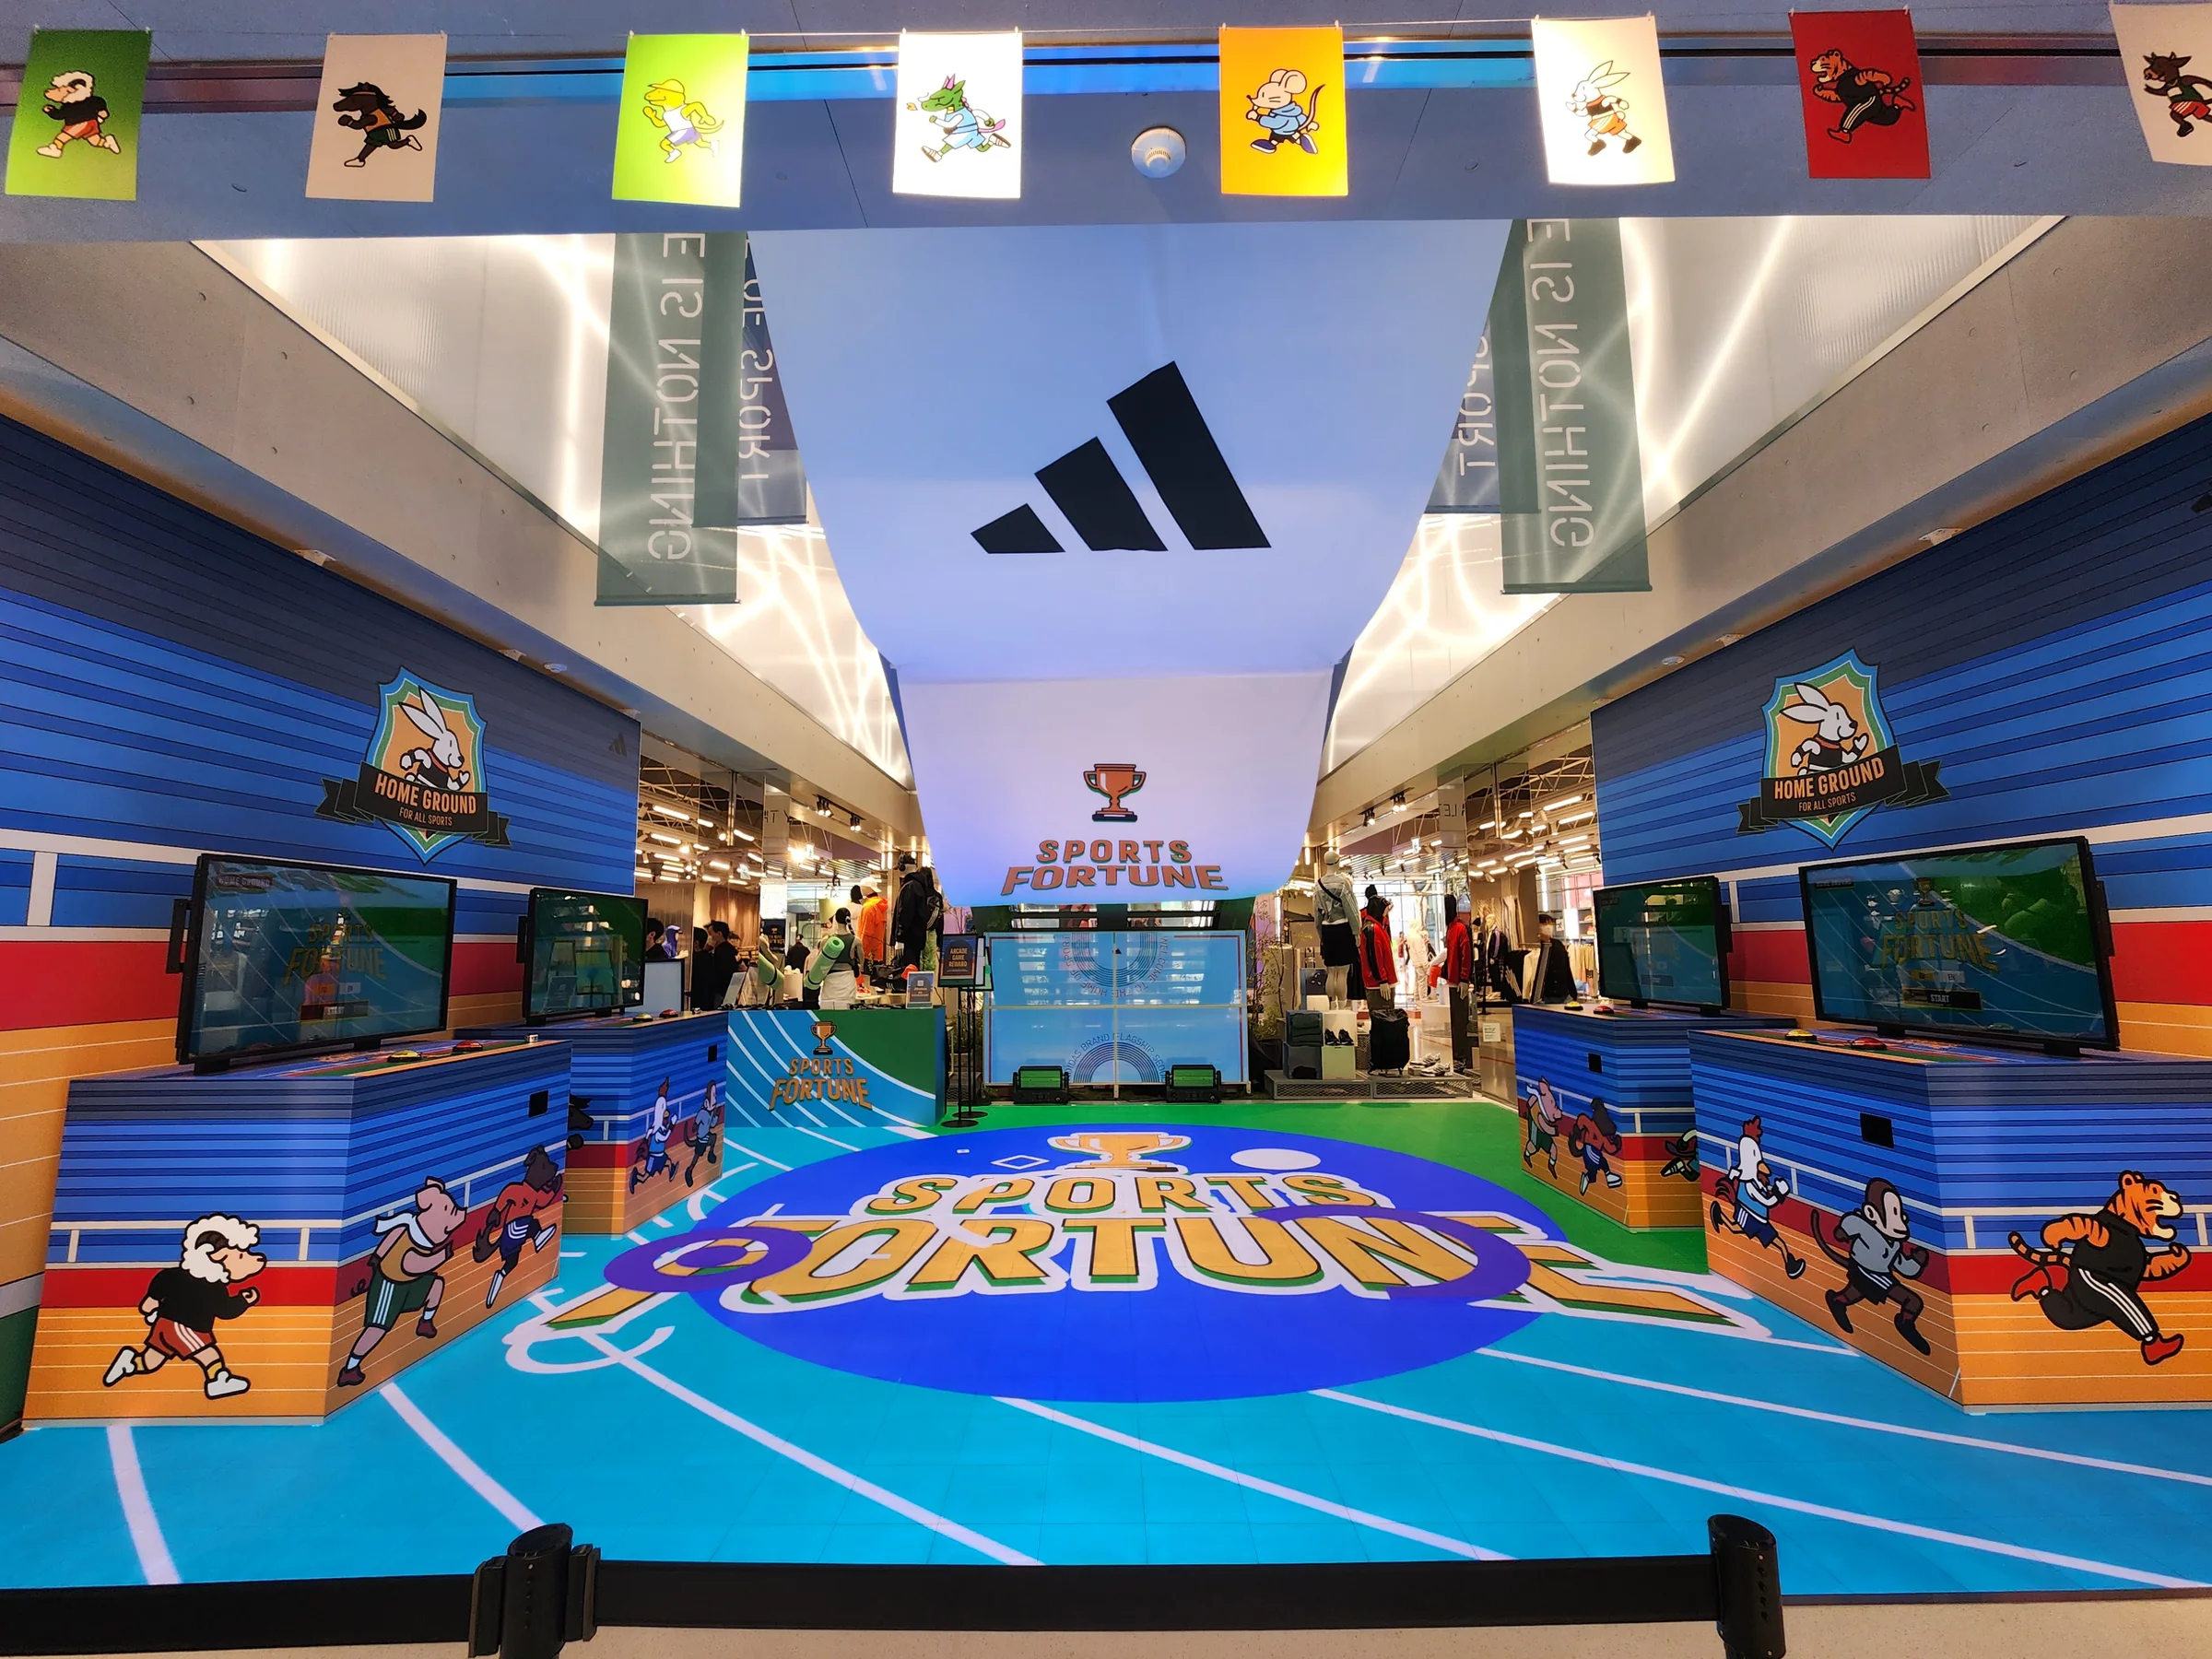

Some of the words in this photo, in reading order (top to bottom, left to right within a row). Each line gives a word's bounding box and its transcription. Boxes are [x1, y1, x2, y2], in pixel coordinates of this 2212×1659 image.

[1774, 776, 1815, 799] HOME
[1819, 757, 1884, 794] GROUND
[375, 774, 418, 806] HOME
[422, 789, 477, 814] GROUND
[1798, 801, 1812, 812] FOR
[1813, 798, 1827, 809] ALL
[1828, 792, 1856, 808] SPORTS
[399, 806, 413, 820] FOR
[414, 809, 427, 824] ALL
[428, 812, 453, 827] SPORTS
[1036, 840, 1192, 864] SPORTS
[1000, 865, 1229, 896] FORTUNE
[1895, 909, 1969, 930] SPORTS
[1880, 933, 1999, 972] FORTUNE
[283, 947, 388, 986] FOTUNE
[1930, 994, 1950, 1003] START
[1080, 1033, 1110, 1052] BRAND
[1112, 1032, 1155, 1053] FLAGSHIP
[788, 1058, 854, 1076] SPORTS
[769, 1077, 874, 1111] FORTUNE
[865, 1175, 1382, 1215] SPORTS
